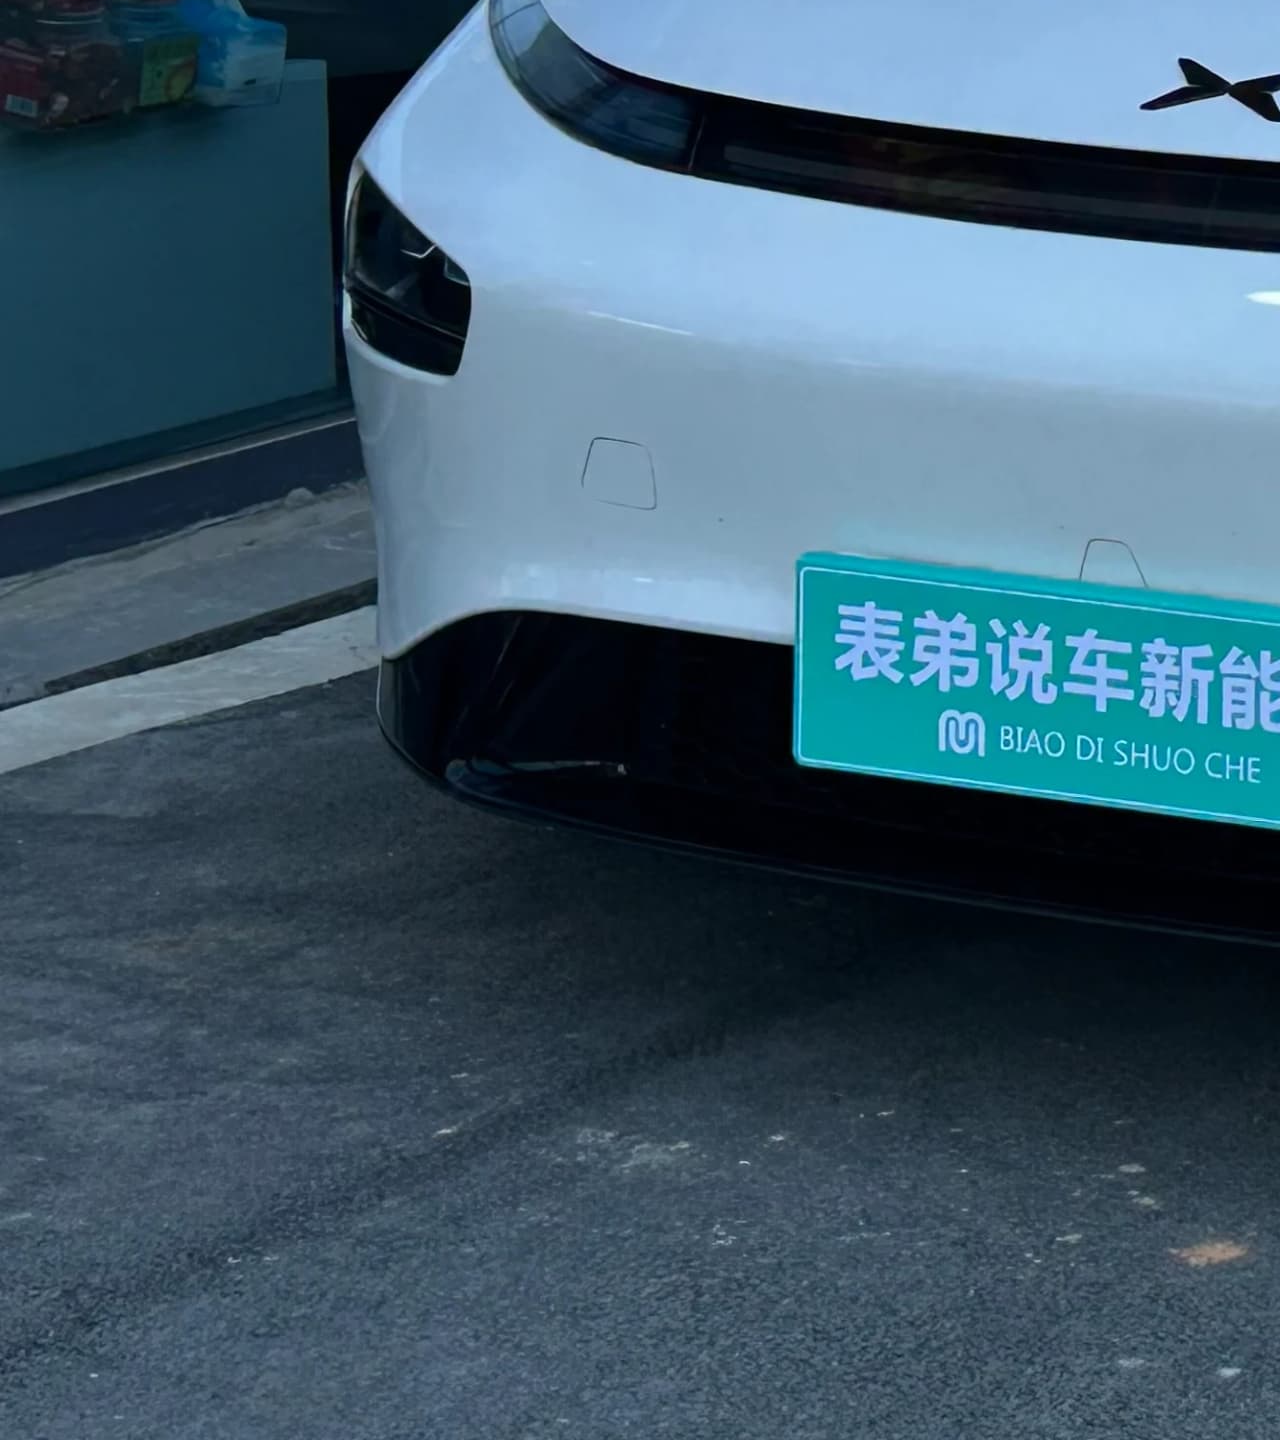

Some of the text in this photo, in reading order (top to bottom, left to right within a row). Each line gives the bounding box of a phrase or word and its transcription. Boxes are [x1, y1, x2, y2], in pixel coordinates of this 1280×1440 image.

[1000, 725, 1262, 784] BIAO DI SHUO CHE
